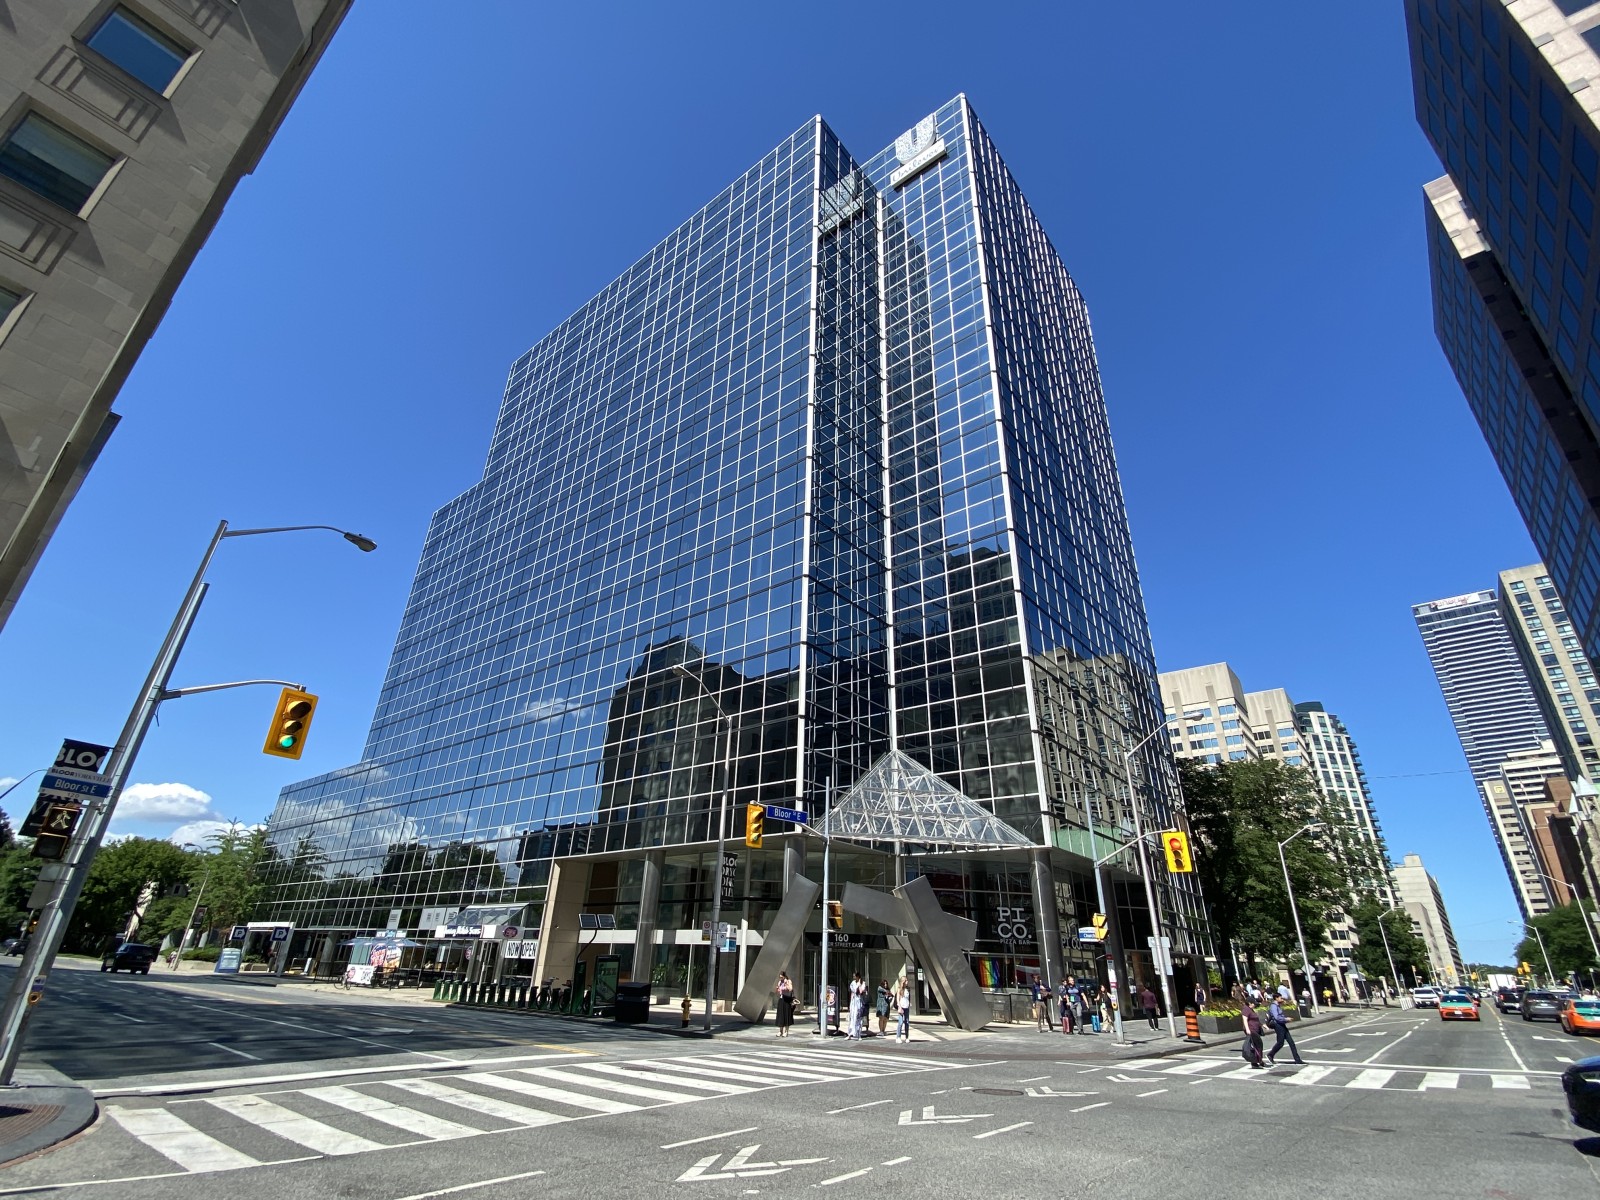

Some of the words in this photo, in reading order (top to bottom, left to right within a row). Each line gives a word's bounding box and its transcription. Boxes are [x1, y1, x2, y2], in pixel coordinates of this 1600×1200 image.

[54, 779, 81, 791] Bloor
[90, 785, 97, 794] E
[774, 808, 791, 818] Bloor
[996, 906, 1026, 922] PI
[834, 933, 849, 942] 160
[997, 922, 1032, 939] CO.
[507, 941, 520, 957] NOW
[521, 942, 538, 957] OPEN
